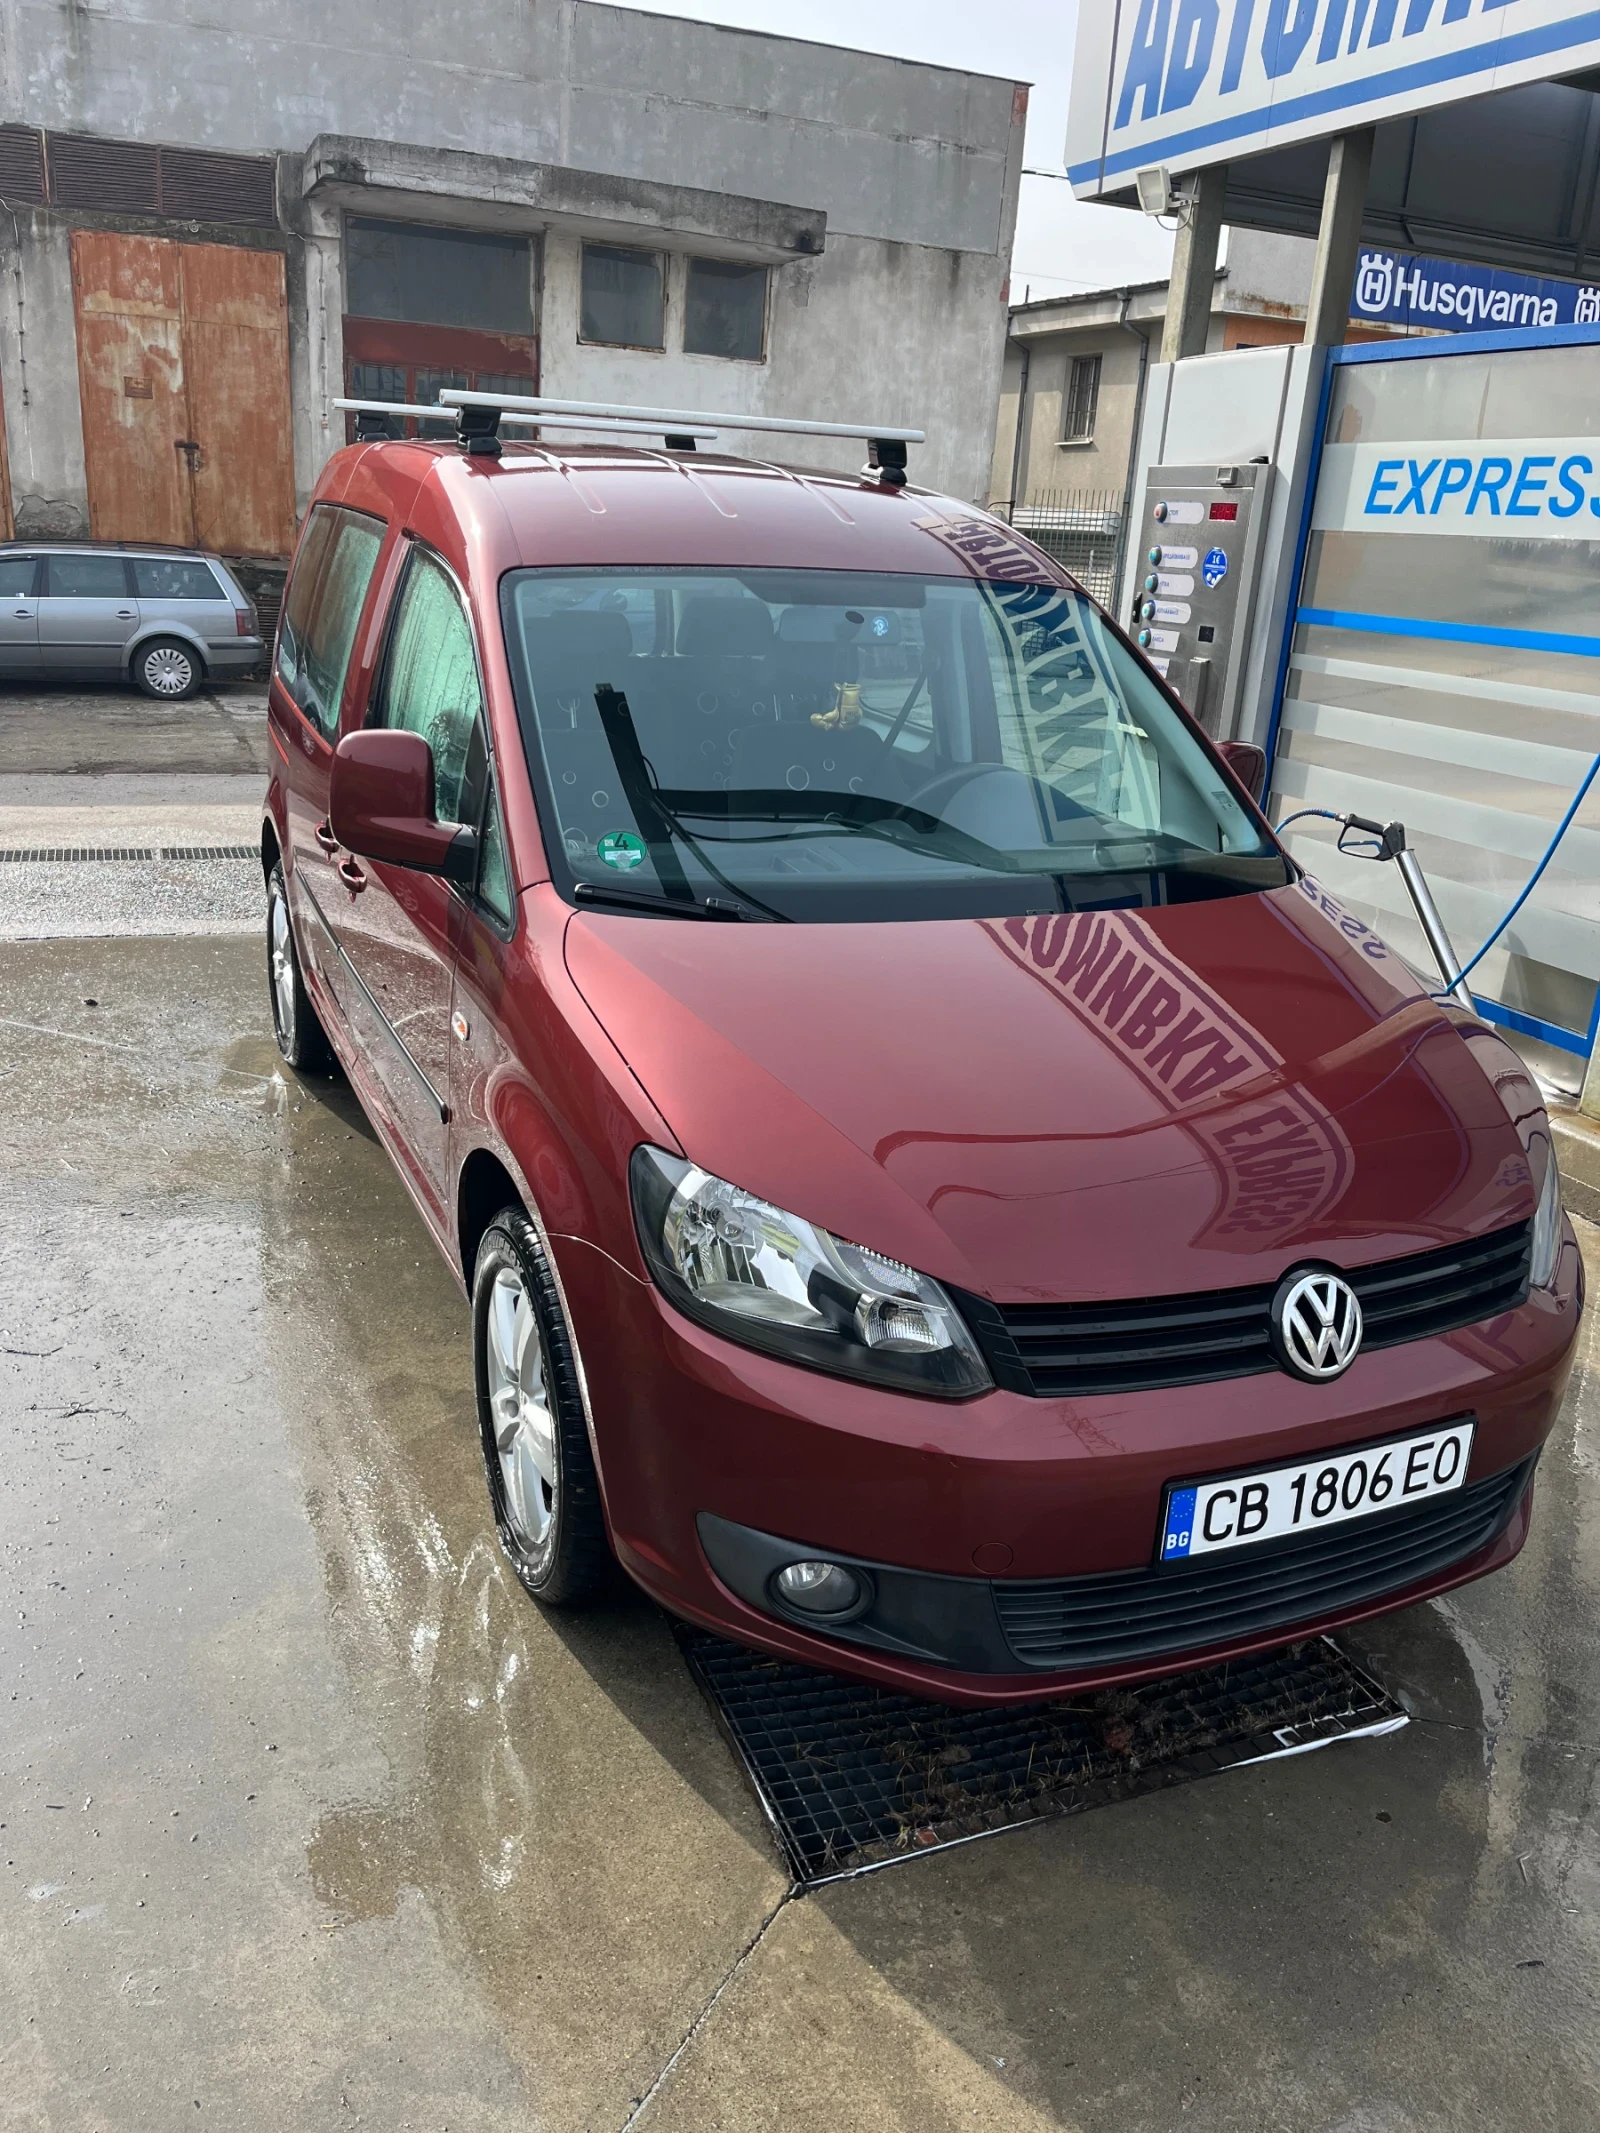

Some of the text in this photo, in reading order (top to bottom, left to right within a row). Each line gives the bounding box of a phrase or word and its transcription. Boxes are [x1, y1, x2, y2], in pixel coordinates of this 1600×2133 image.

[1393, 266, 1558, 327] Husqvarna
[1363, 455, 1600, 518] EXPRES
[615, 833, 629, 850] 4
[1202, 1435, 1461, 1542] CB 1806 EO
[1166, 1531, 1189, 1550] BG
